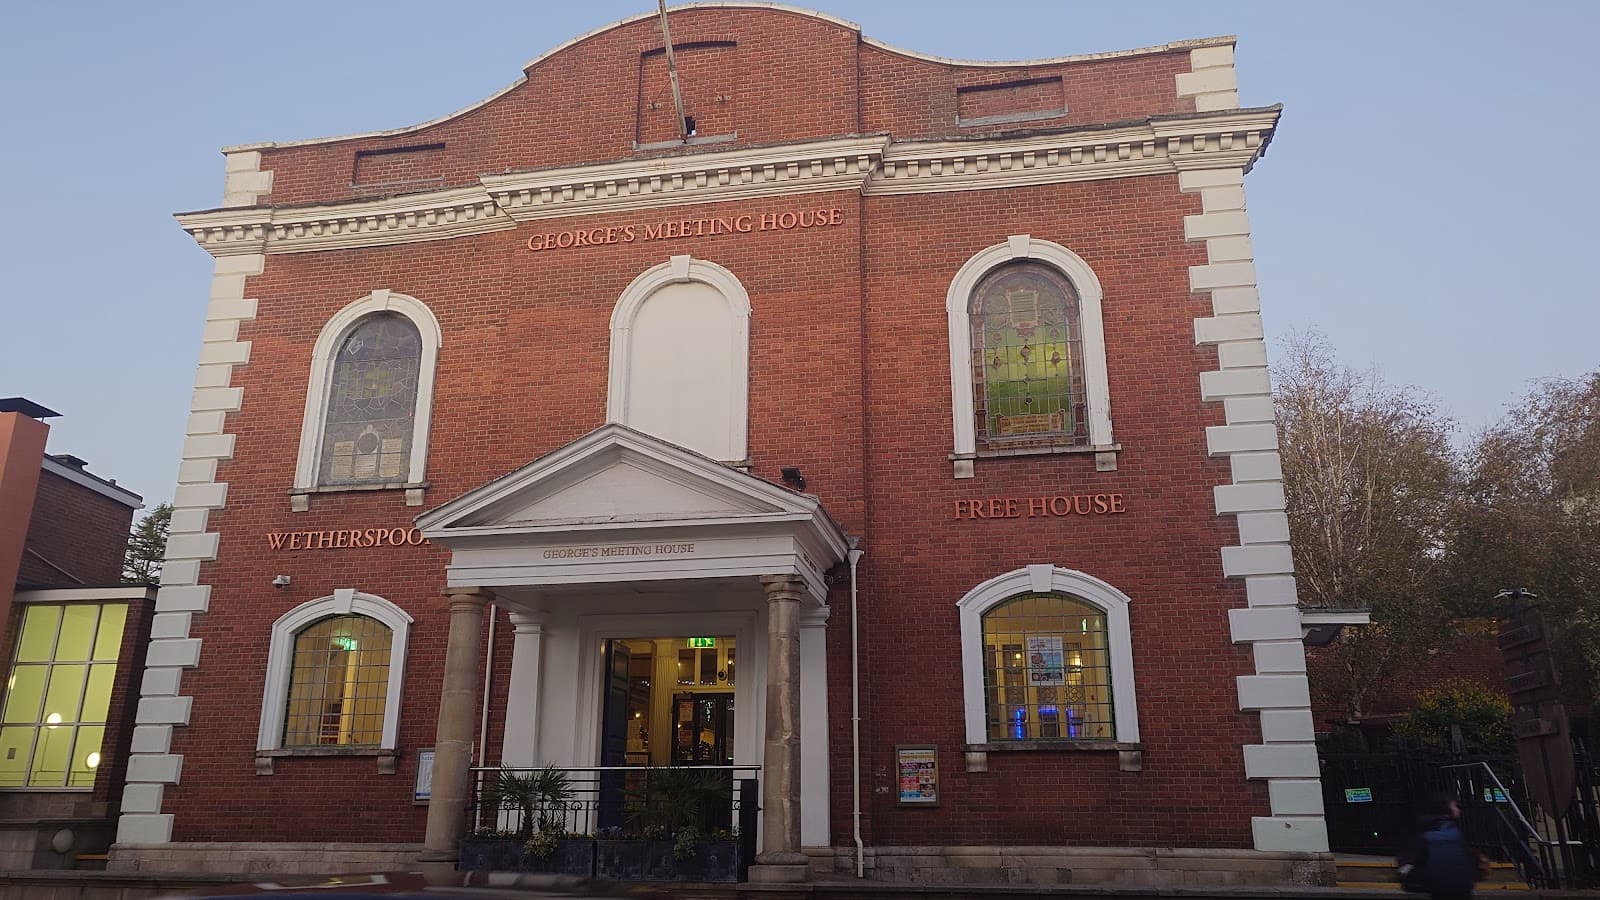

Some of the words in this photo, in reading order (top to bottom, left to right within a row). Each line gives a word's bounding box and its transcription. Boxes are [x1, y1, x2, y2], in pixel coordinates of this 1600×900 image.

[527, 225, 636, 251] GEORGE'S
[643, 214, 753, 241] MEETING
[759, 208, 843, 232] HOUSE
[954, 498, 1021, 519] FREE
[1028, 493, 1126, 518] HOUSE
[267, 528, 432, 550] WETHERSPOO
[543, 547, 599, 560] GEORGE'S
[601, 545, 652, 558] MEETING
[655, 543, 695, 555] HOUSE
